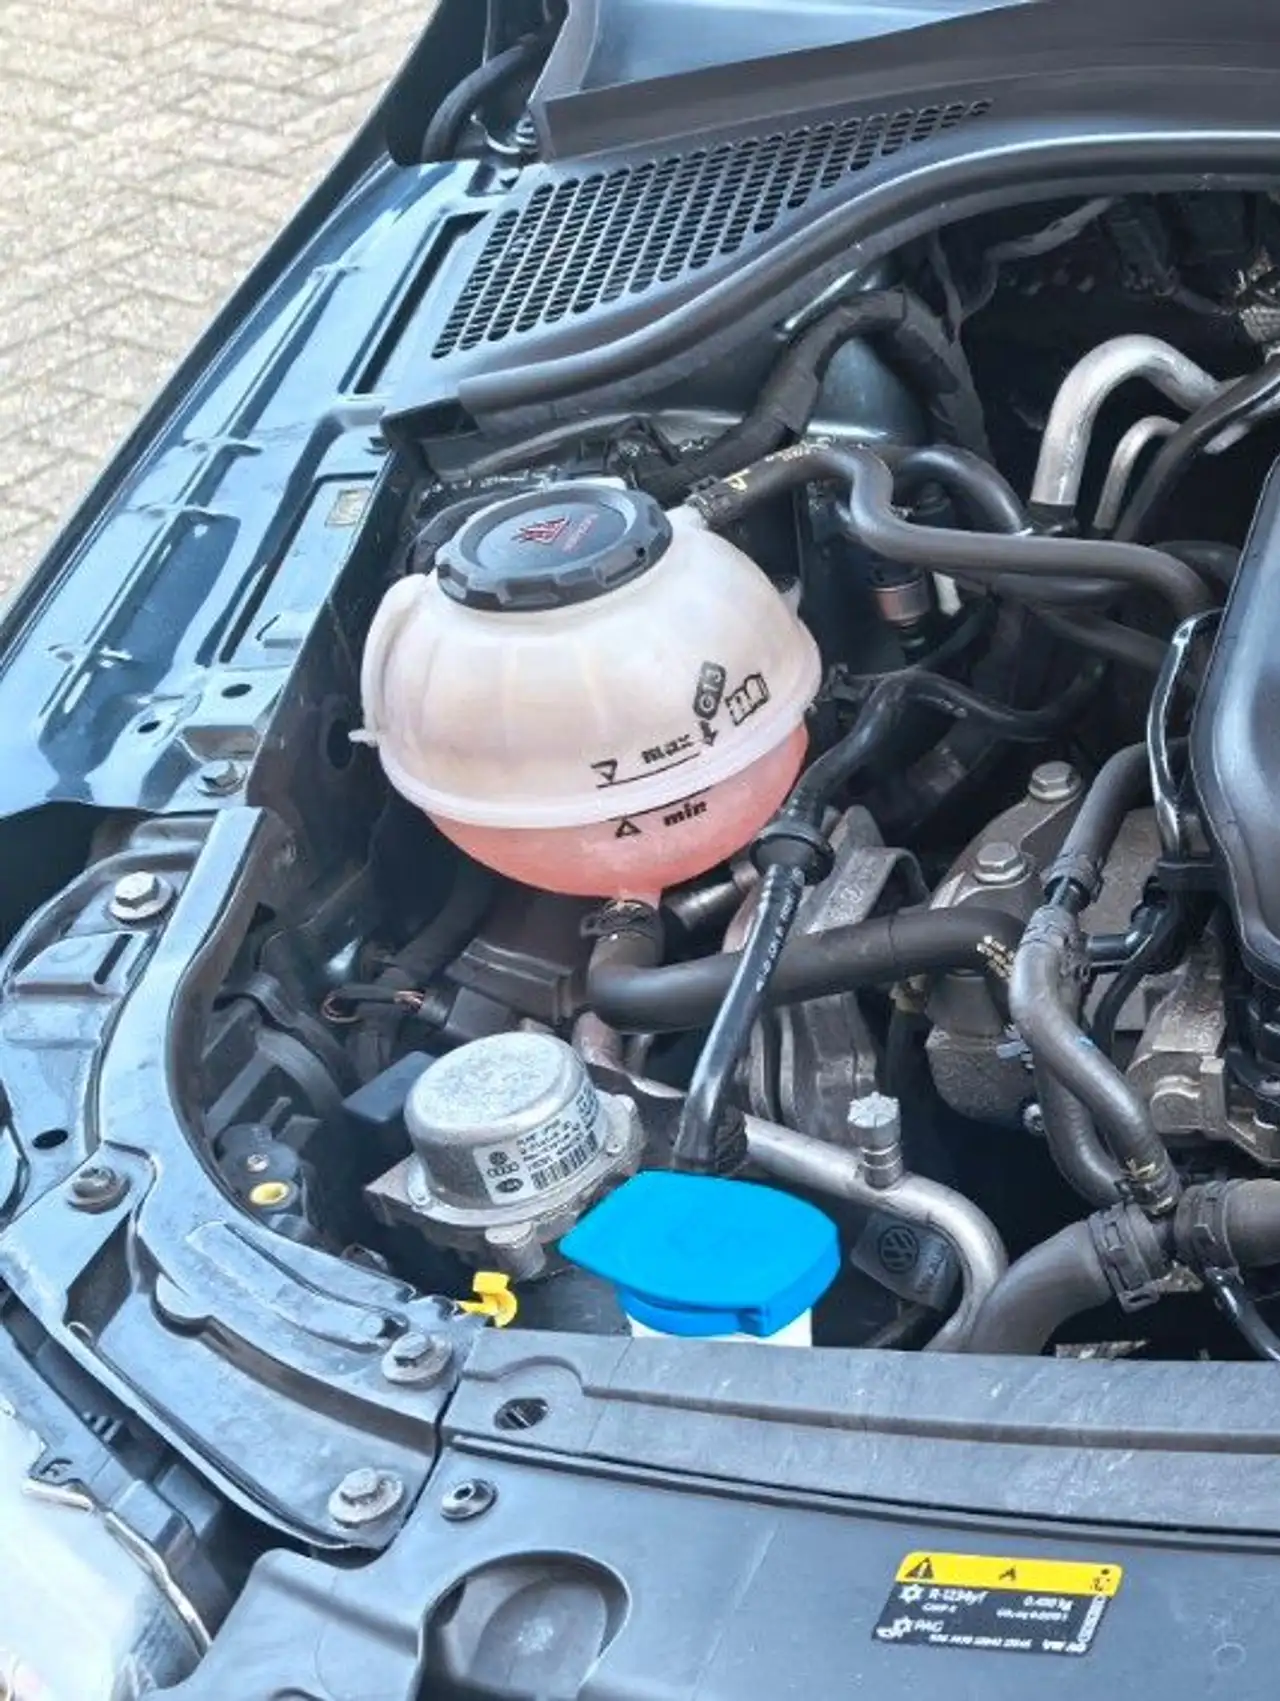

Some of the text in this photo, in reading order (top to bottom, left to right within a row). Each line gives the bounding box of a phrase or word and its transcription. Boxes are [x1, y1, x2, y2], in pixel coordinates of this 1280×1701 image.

[698, 667, 723, 714] G13
[641, 733, 694, 764] max
[663, 801, 708, 827] min
